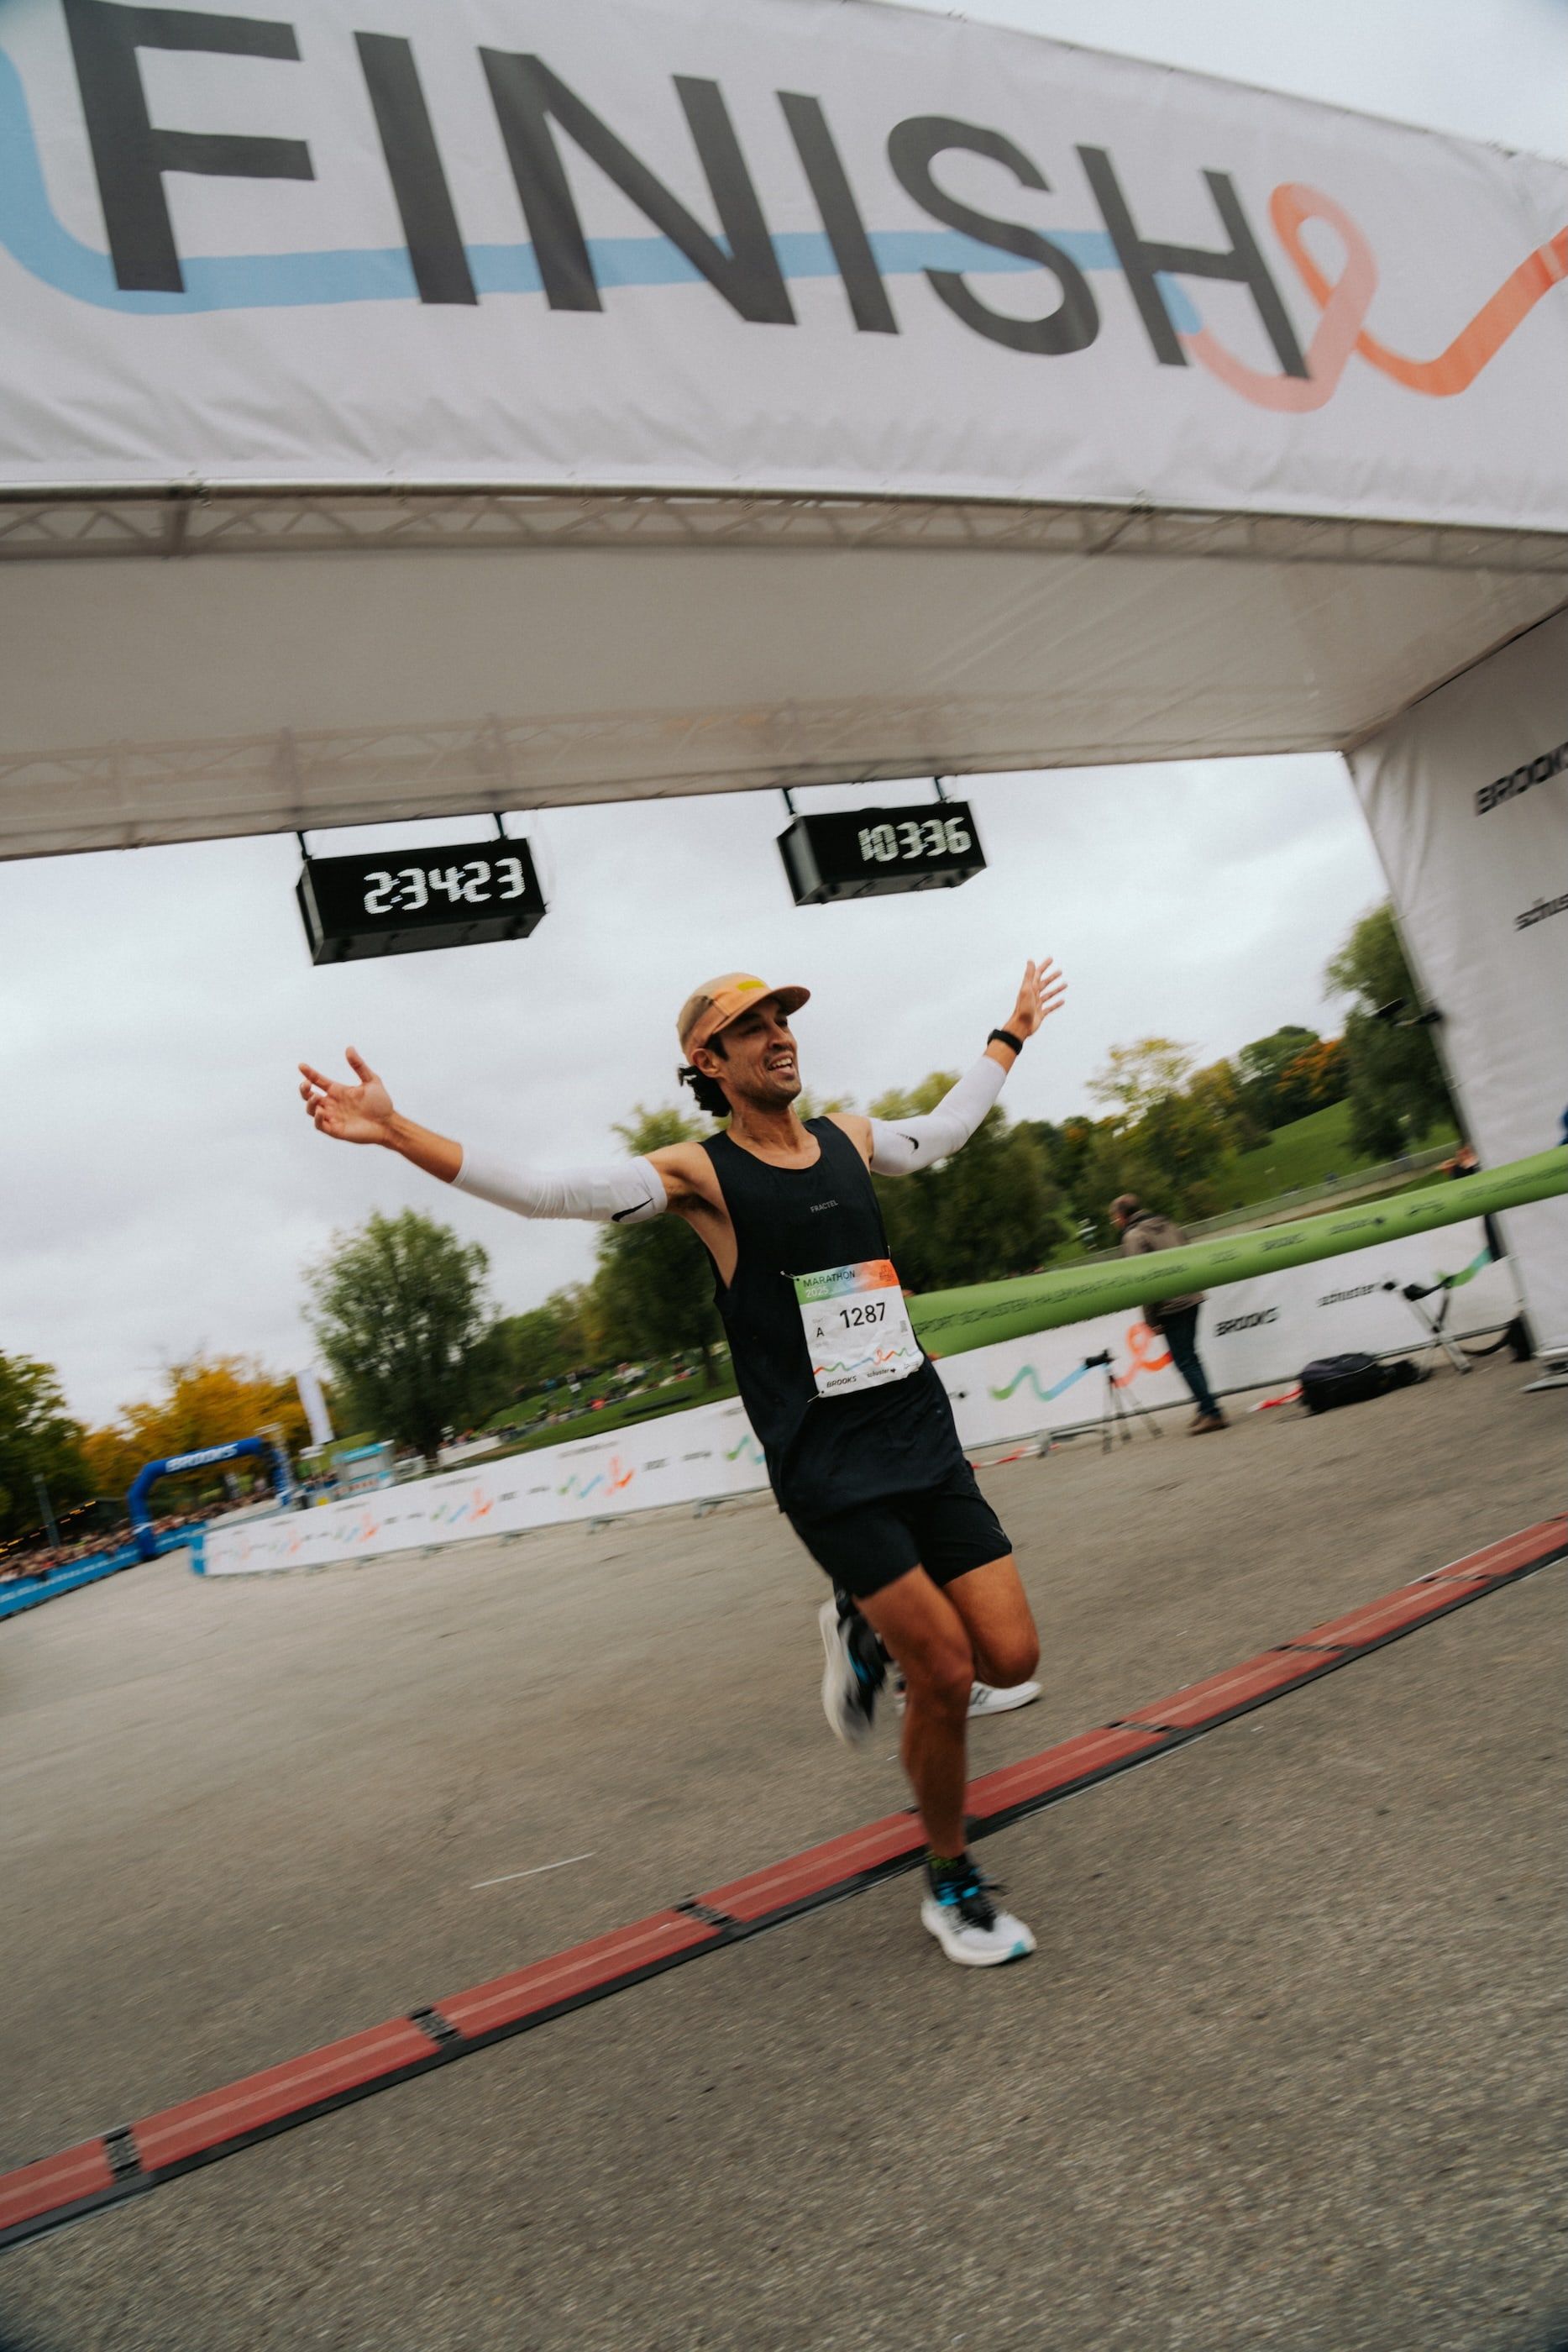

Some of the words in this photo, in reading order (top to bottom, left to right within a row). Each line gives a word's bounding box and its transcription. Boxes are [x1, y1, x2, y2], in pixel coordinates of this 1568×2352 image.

[62, 0, 1311, 380] FINISH
[1475, 743, 1568, 816] BROOK
[810, 1200, 839, 1213] FRACTEL
[803, 1270, 855, 1288] MARATHON
[805, 1287, 828, 1298] 2025
[840, 1302, 885, 1328] 1287
[816, 1327, 825, 1337] A
[826, 1375, 857, 1388] BROOKS
